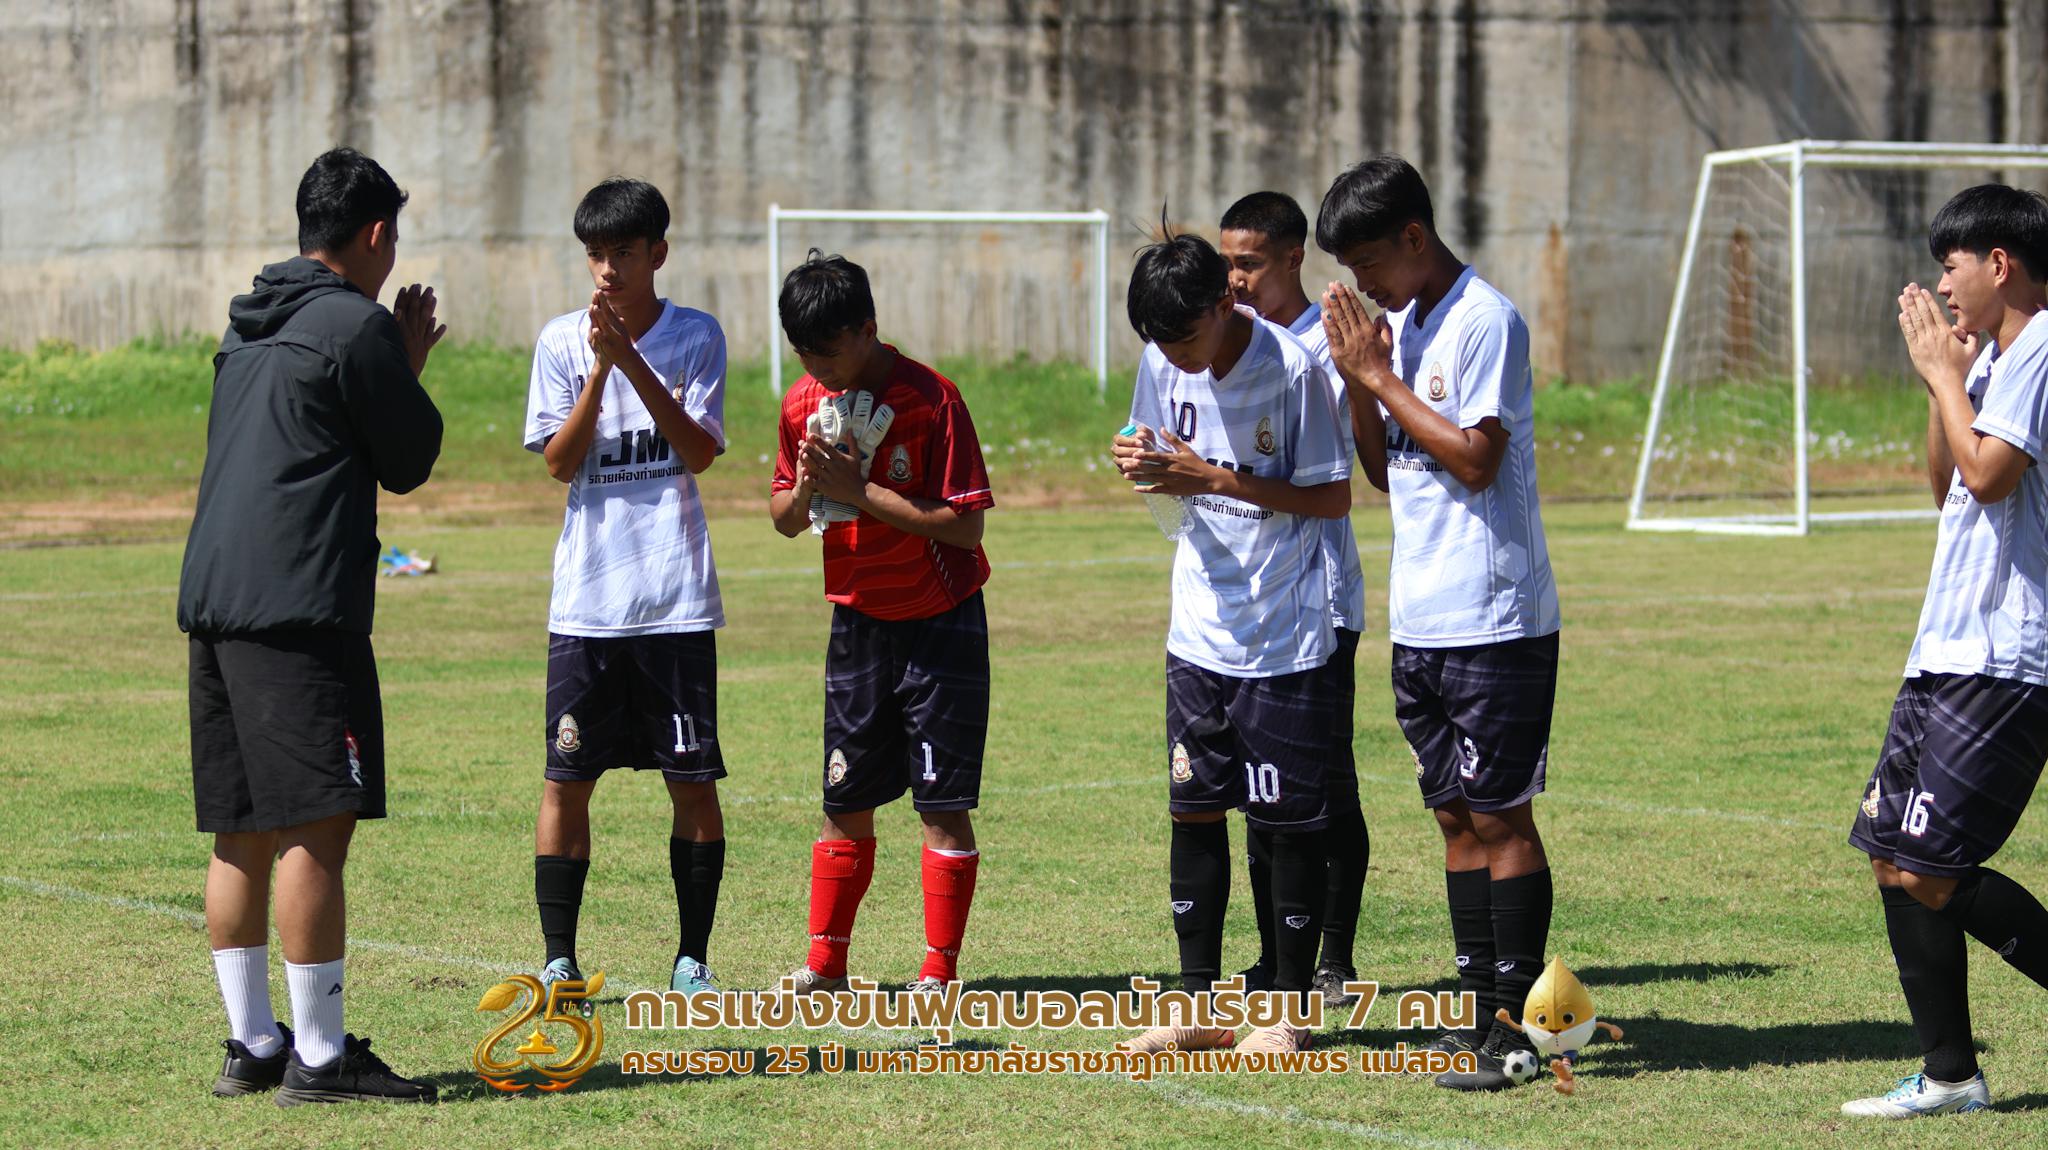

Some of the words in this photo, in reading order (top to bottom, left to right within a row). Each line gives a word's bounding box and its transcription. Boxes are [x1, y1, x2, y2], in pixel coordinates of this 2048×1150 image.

[600, 428, 669, 468] JM
[672, 713, 701, 753] 11
[921, 742, 937, 783] 1
[1460, 736, 1480, 779] 3
[1245, 761, 1281, 804] 10
[1900, 787, 1935, 837] 16
